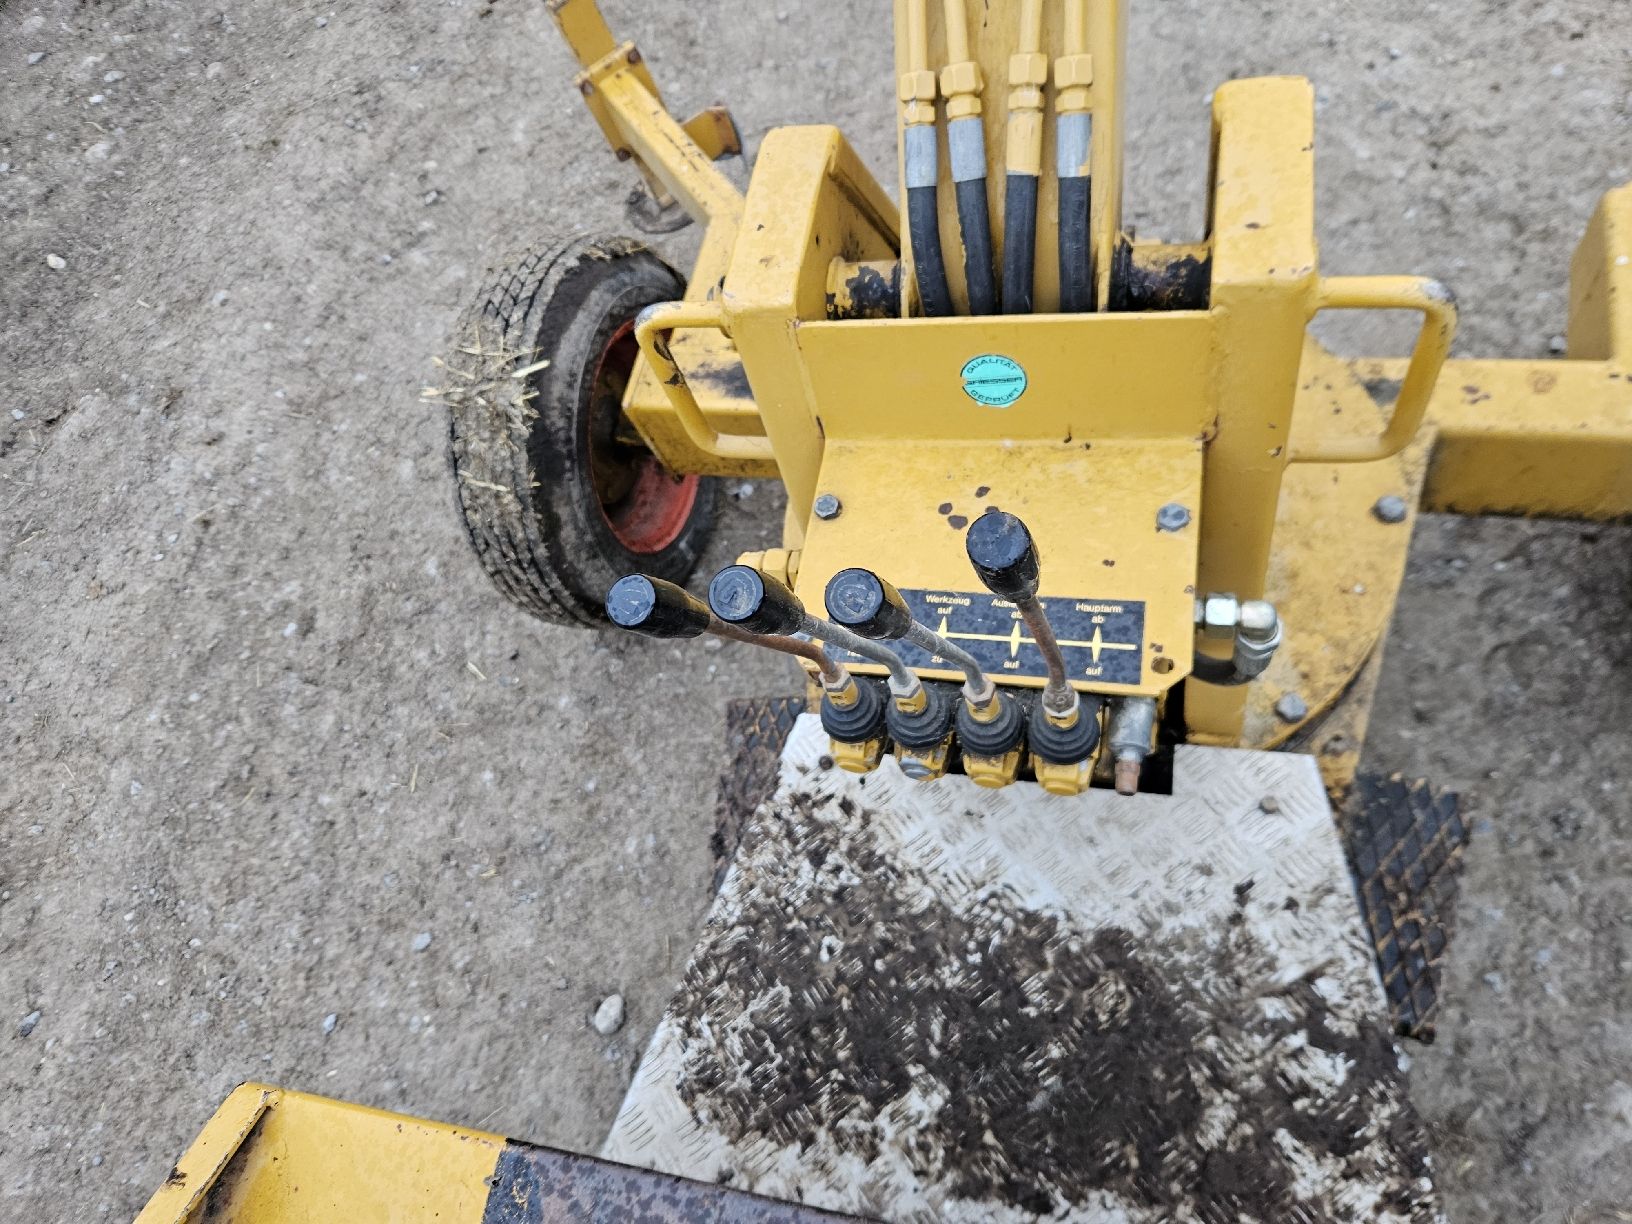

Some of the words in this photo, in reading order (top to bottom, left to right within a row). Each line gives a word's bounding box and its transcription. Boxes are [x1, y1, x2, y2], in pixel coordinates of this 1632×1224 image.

[926, 595, 971, 606] Werkzeug
[938, 605, 953, 614] auf
[1076, 603, 1124, 614] Hauptarm
[1091, 614, 1105, 624] ab
[1003, 660, 1019, 669] auf
[1086, 666, 1103, 676] auf
